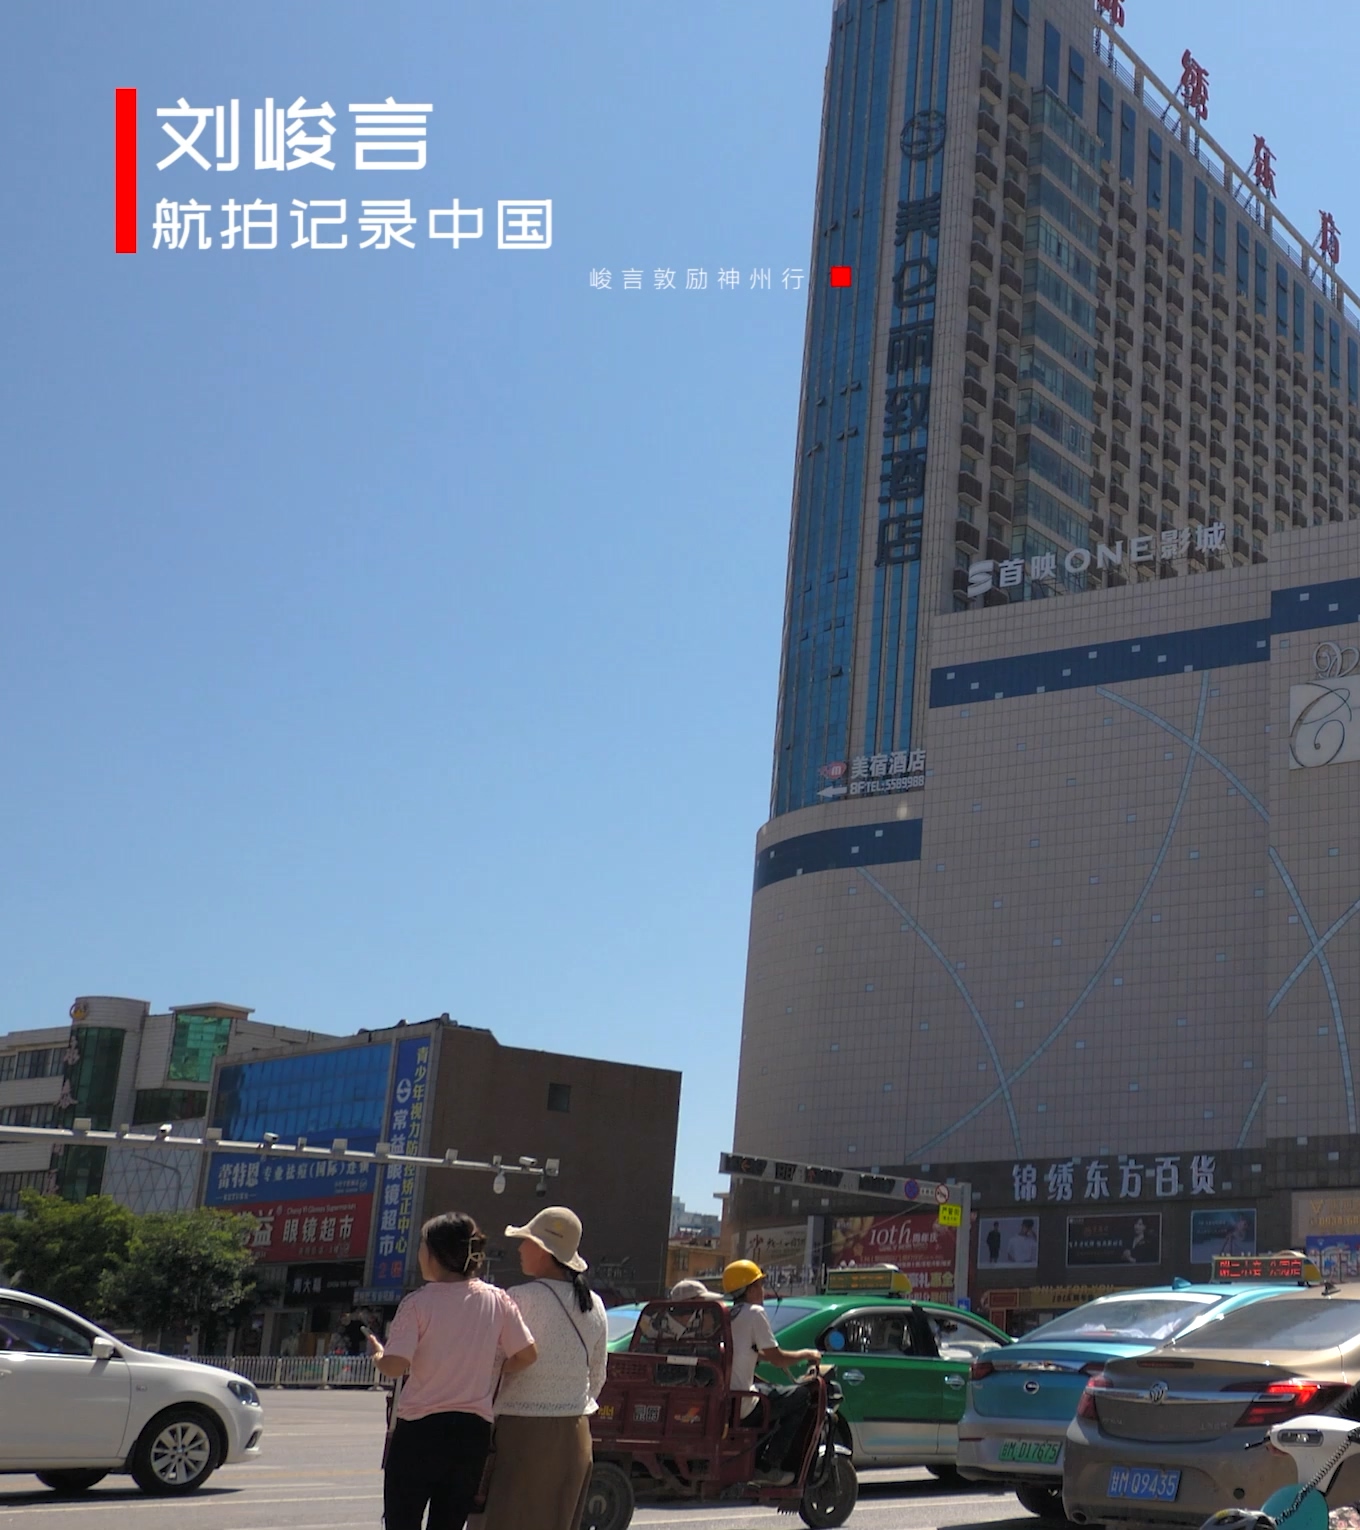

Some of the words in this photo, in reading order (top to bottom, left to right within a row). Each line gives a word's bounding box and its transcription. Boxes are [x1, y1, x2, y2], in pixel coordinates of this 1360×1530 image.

[851, 748, 926, 780] 美宿酒店
[378, 1109, 410, 1258] 常益眼镜超市
[1011, 1154, 1218, 1202] 锦绣东方百货
[281, 1214, 355, 1244] 眼镜超市
